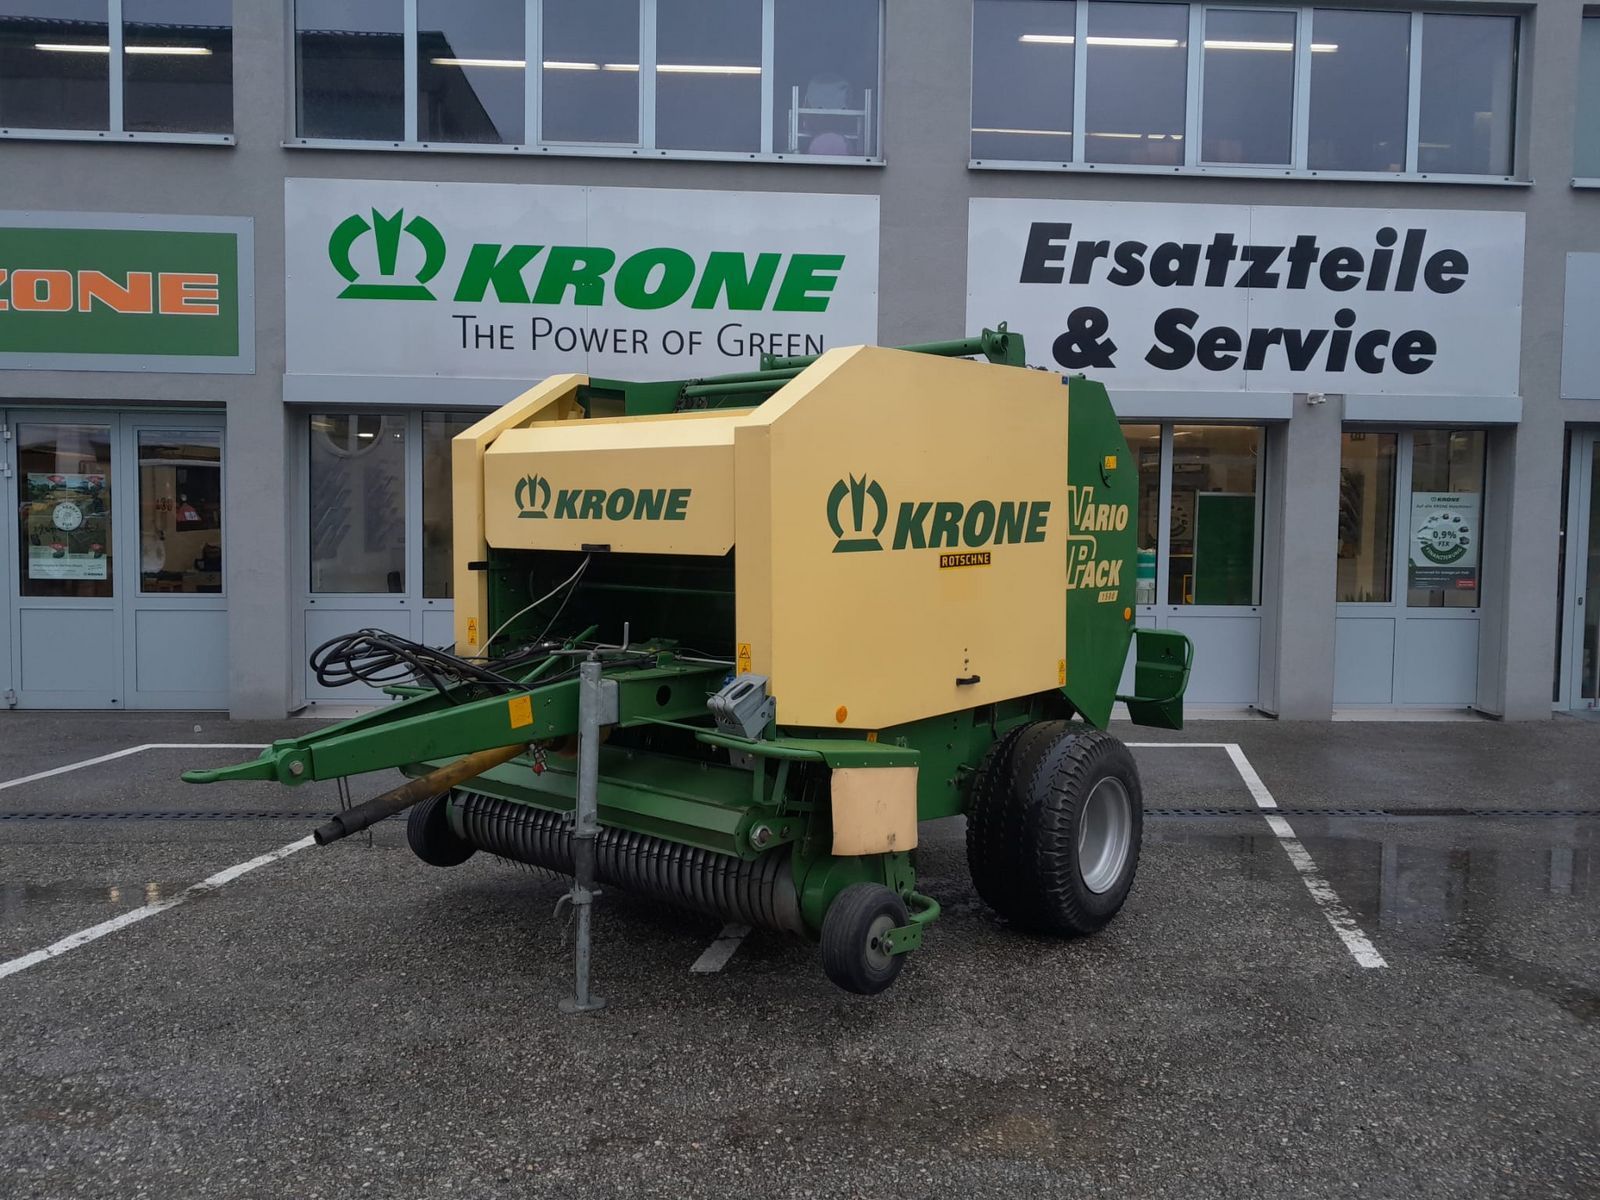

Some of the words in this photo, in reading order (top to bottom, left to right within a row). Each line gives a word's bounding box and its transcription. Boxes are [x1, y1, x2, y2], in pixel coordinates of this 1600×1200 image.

[453, 243, 846, 312] KRONE
[1019, 221, 1469, 294] Ersatzteile
[0, 269, 219, 316] ONE
[1052, 306, 1118, 369] &
[1144, 307, 1437, 375] Service
[553, 488, 692, 521] KRONE
[892, 499, 1051, 551] KRONE
[1067, 485, 1129, 532] VARIO
[1432, 530, 1457, 540] 0,9%
[941, 553, 990, 567] ROTSCHNE
[1067, 534, 1123, 590] PACK
